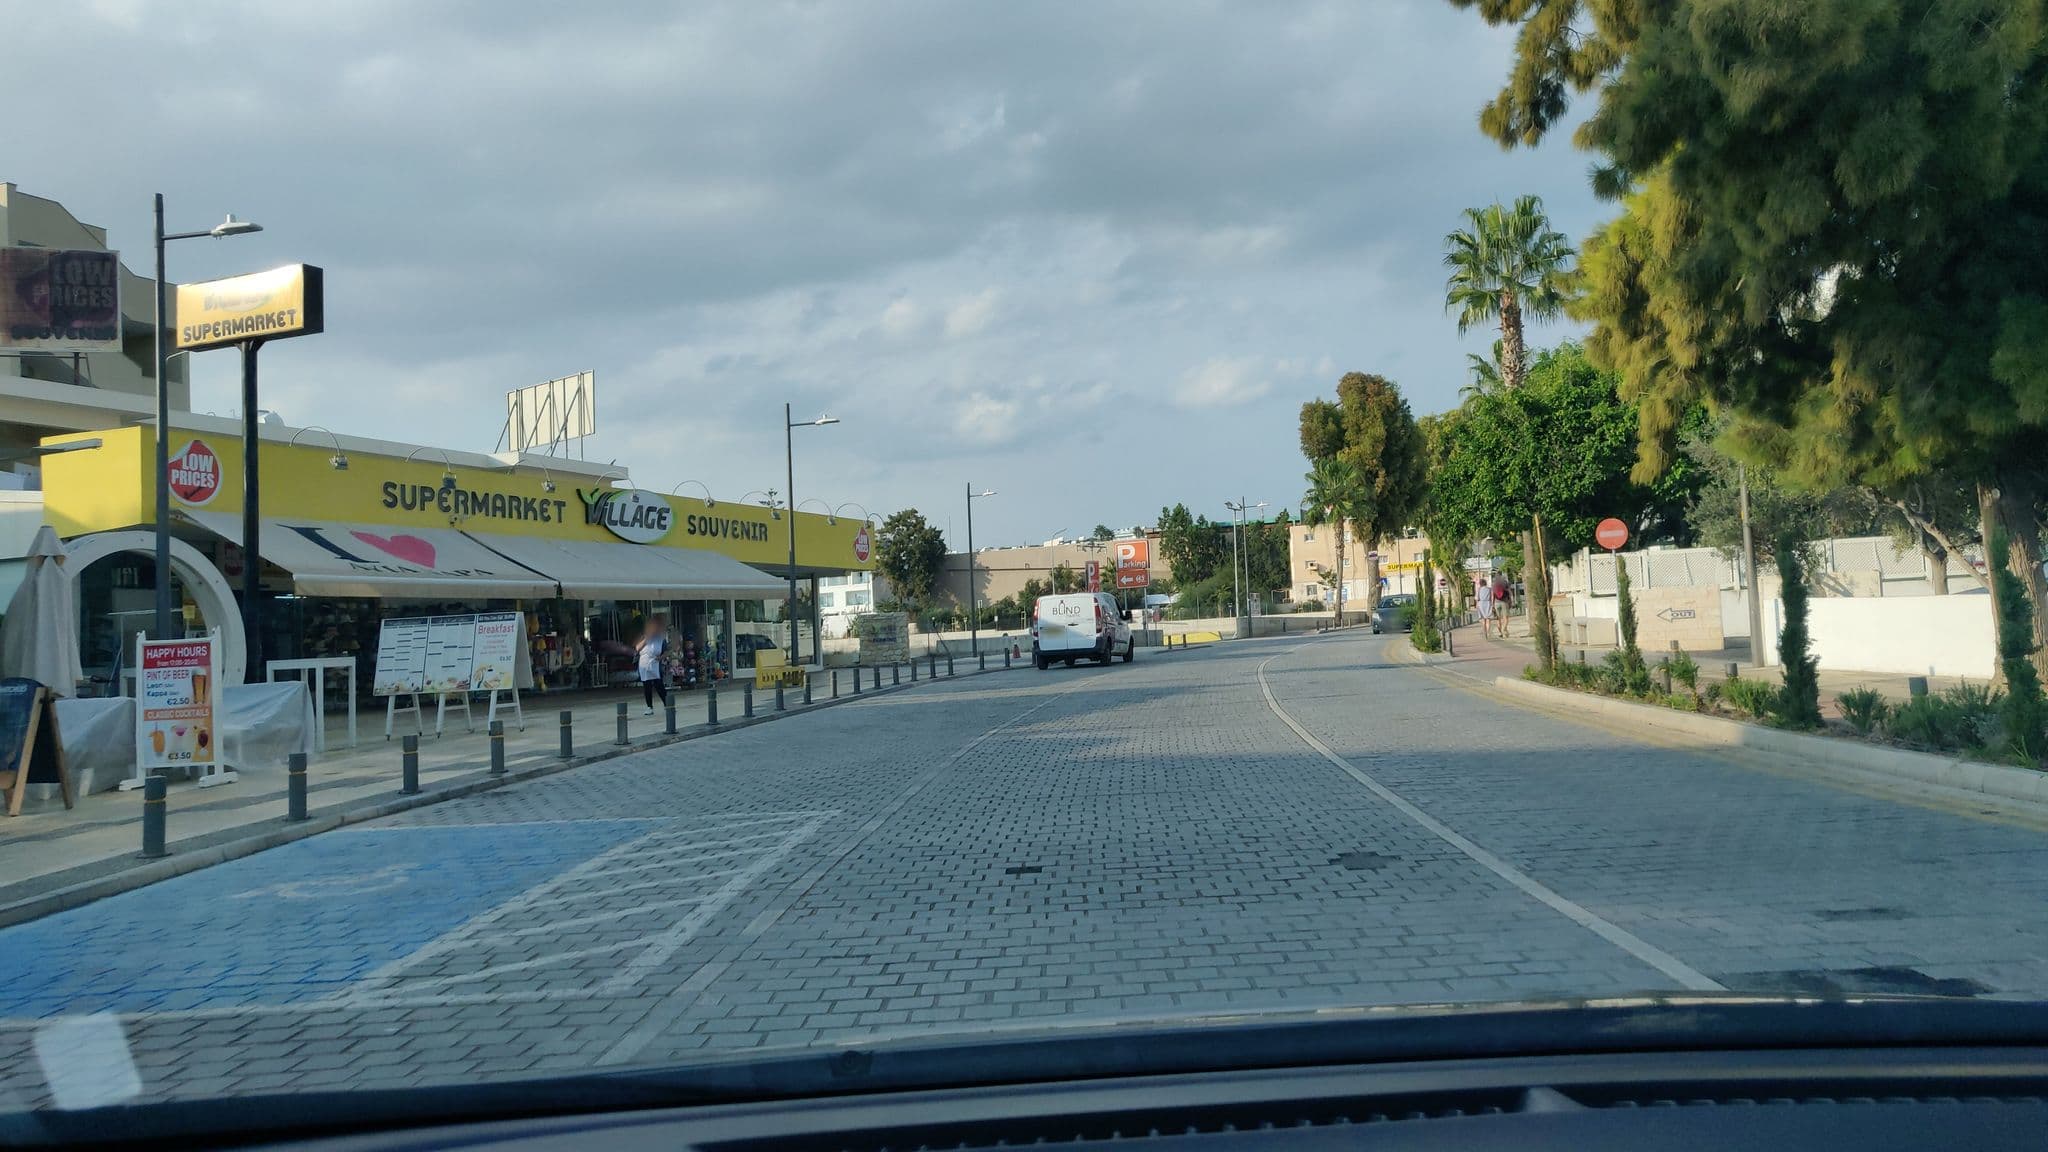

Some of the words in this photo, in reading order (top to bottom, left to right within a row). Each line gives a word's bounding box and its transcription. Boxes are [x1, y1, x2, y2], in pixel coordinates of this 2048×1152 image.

[183, 308, 297, 343] SUPERMARKET
[182, 453, 214, 473] LOW
[171, 469, 215, 489] PRICES
[382, 481, 567, 524] SUPERMARKET
[687, 514, 769, 543] SOUVENIR
[1387, 561, 1436, 570] SUPERMARET
[479, 624, 514, 634] Breakfast
[146, 648, 175, 659] HAPPY
[177, 645, 208, 657] HOURS
[147, 671, 161, 680] PINT
[163, 670, 171, 680] OF
[173, 669, 190, 679] BEER
[167, 697, 190, 705] €2.50
